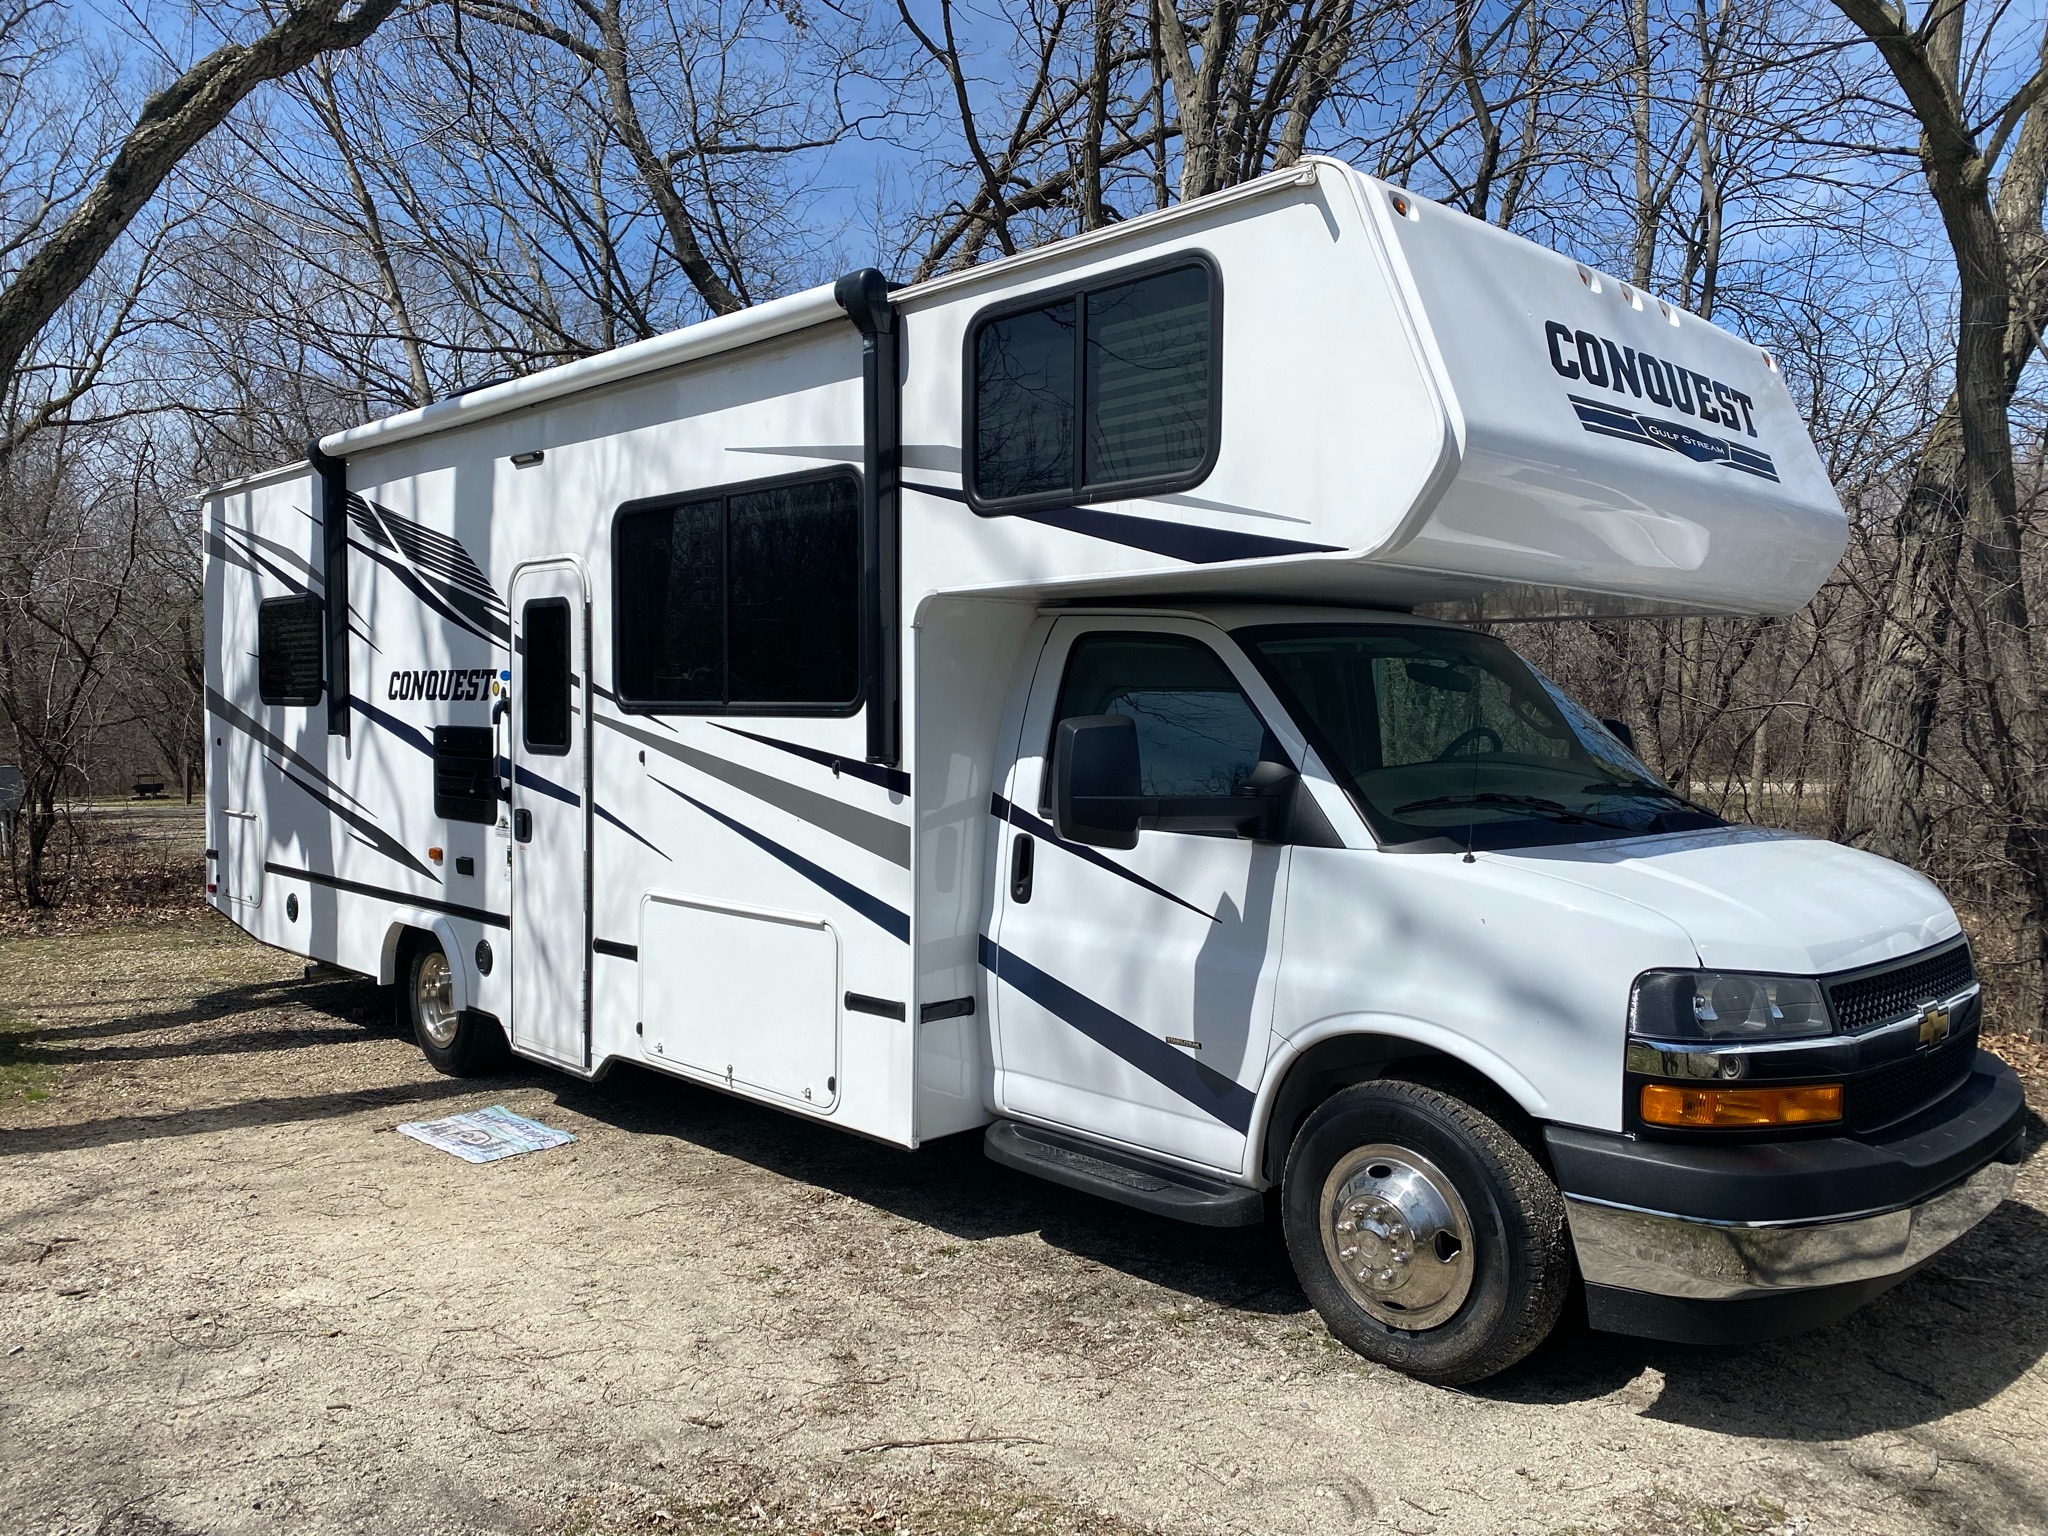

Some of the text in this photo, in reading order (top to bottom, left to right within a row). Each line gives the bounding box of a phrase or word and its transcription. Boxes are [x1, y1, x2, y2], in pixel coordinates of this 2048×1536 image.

[1545, 320, 1758, 438] CONQUEST
[1648, 425, 1726, 455] GULF STREAM
[388, 669, 498, 701] CONQUEST
